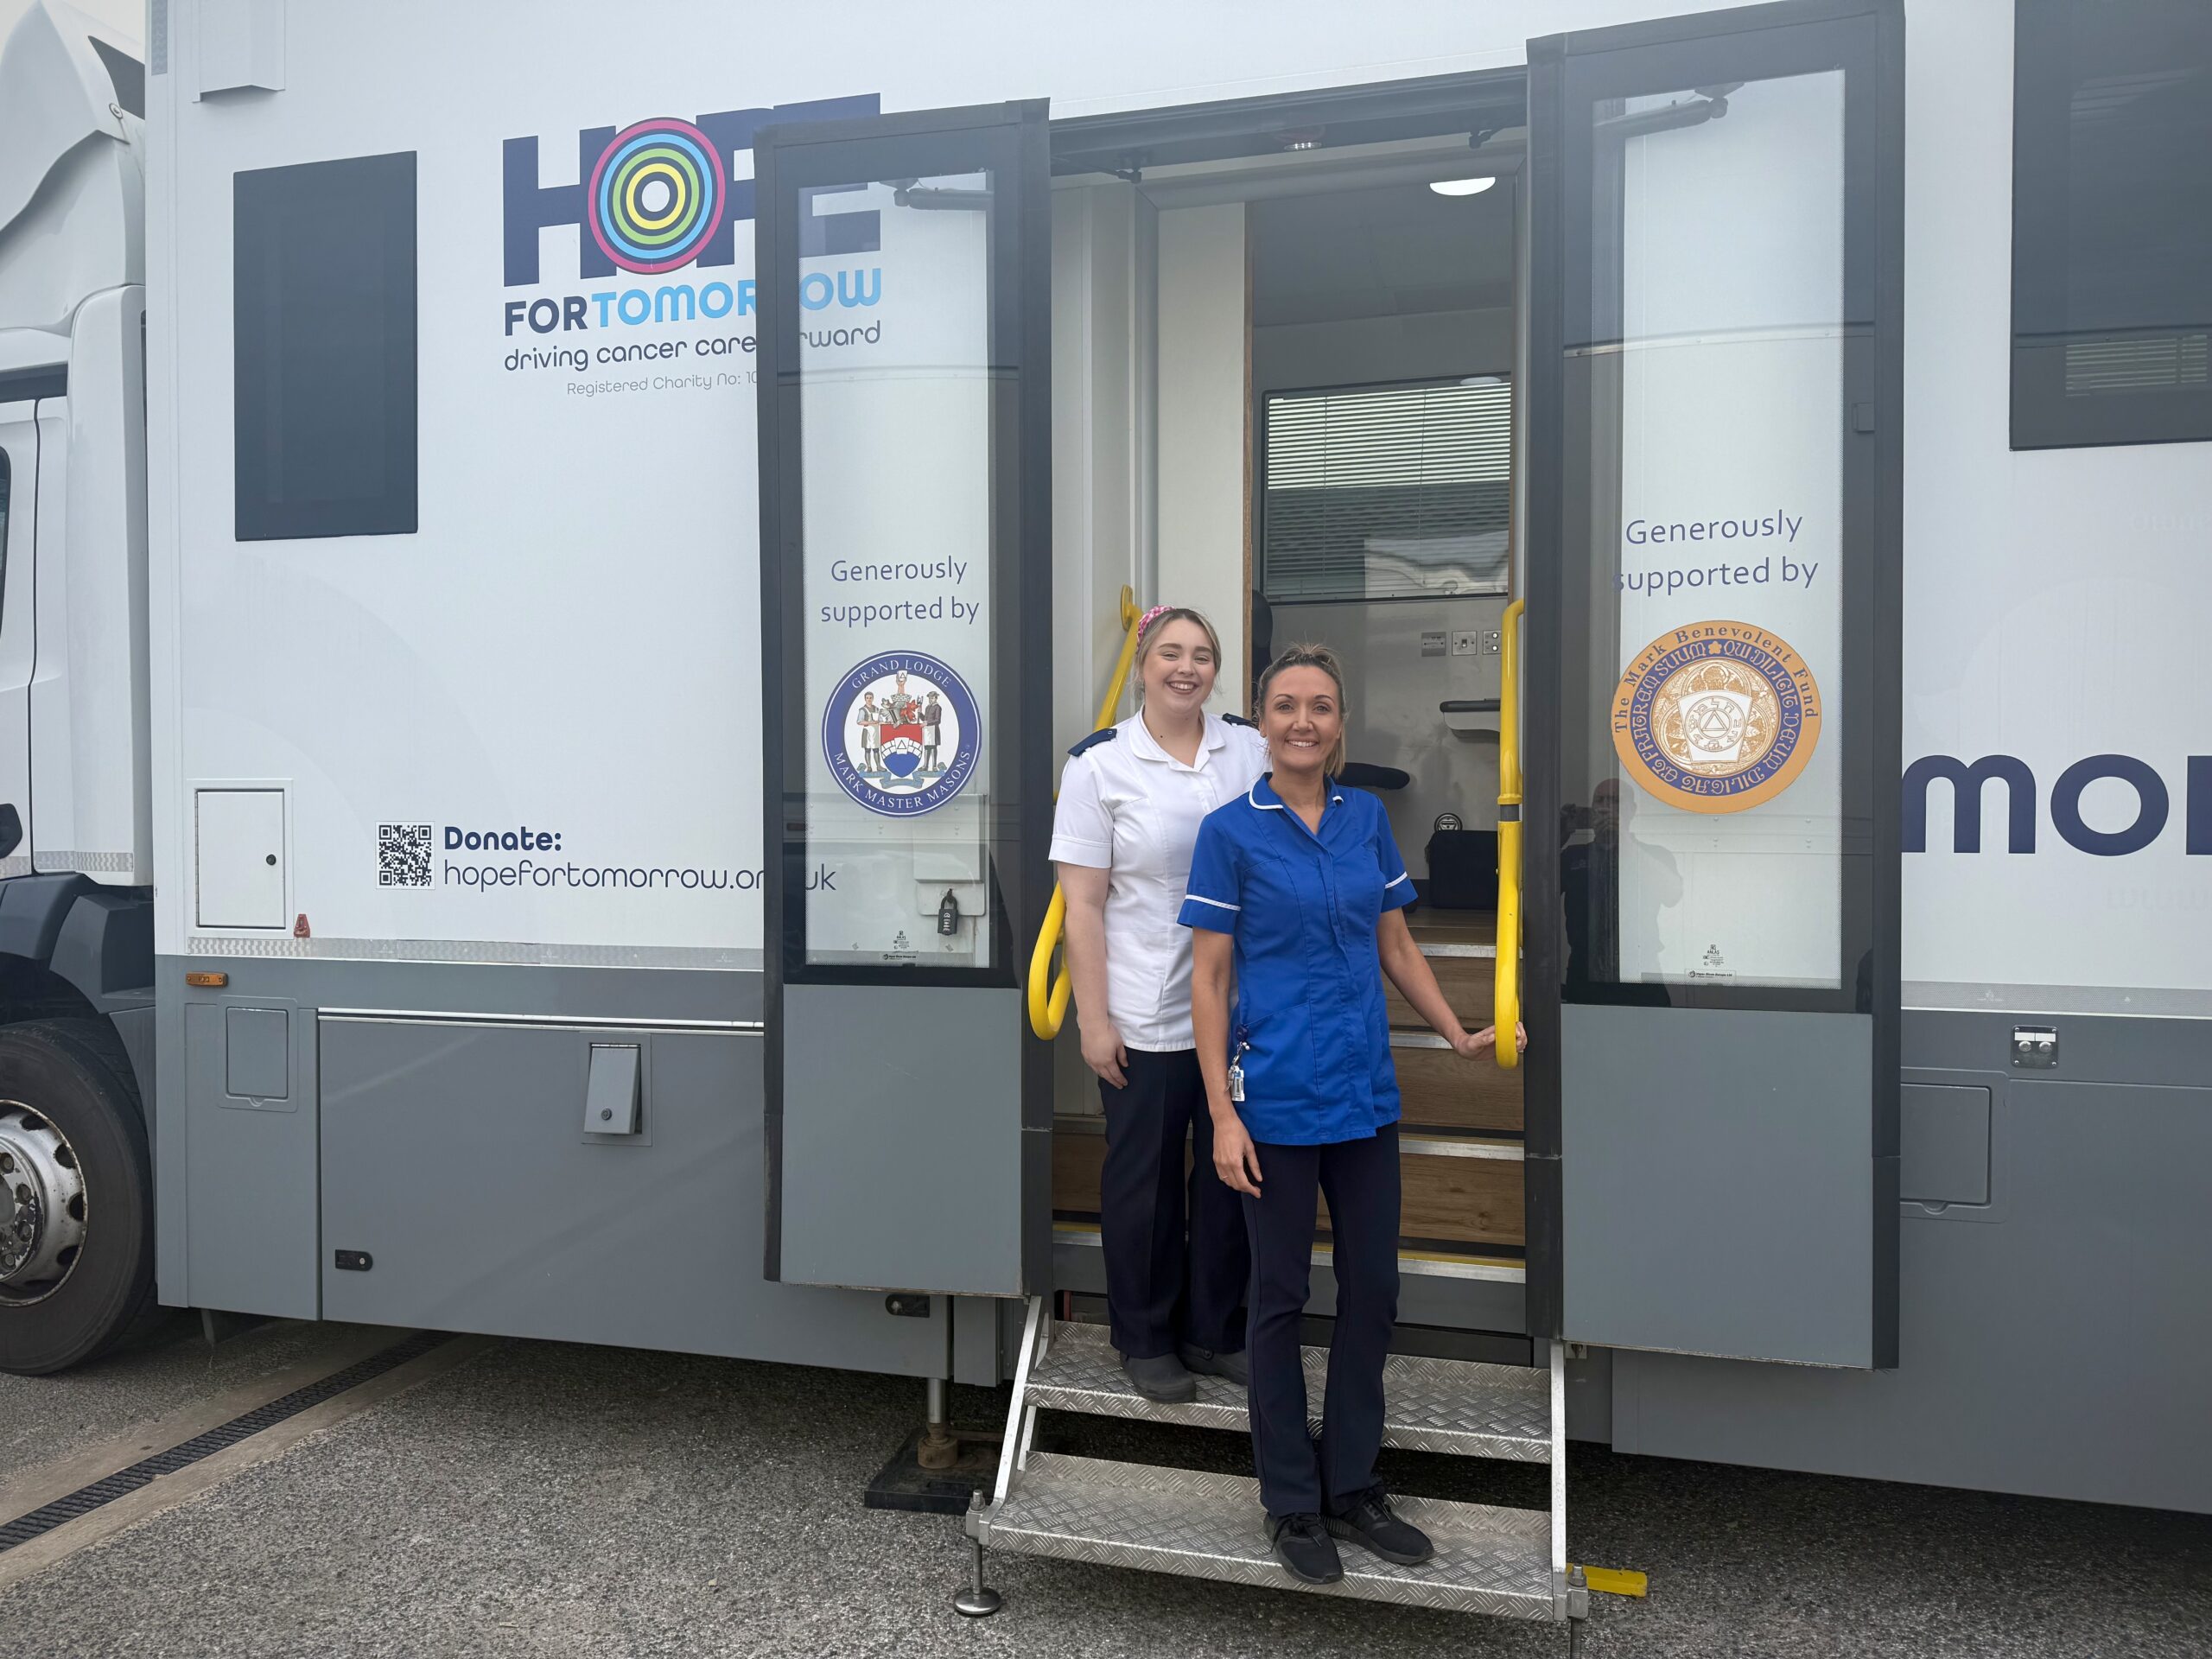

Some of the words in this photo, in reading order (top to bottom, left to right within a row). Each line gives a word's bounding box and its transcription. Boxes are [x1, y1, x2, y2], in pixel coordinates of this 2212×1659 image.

[505, 268, 881, 336] FORTOMOROW
[505, 345, 588, 372] driving
[596, 341, 688, 364] cancer
[695, 334, 756, 357] care
[567, 377, 648, 397] Registered
[652, 372, 712, 390] Charity
[717, 372, 741, 385] No:
[1625, 509, 1802, 544] Generously
[831, 555, 967, 584] Generously
[1612, 556, 1770, 597] supported
[1782, 556, 1819, 588] by
[821, 596, 943, 627] supported
[951, 595, 979, 625] by
[852, 659, 899, 689] GRAND
[905, 659, 952, 688] LODGE
[1615, 696, 1630, 733] The
[1624, 645, 1668, 687] Mark
[1674, 626, 1792, 663] Benevolent
[1793, 667, 1818, 718] Fund
[834, 753, 863, 793] MARK
[865, 789, 924, 809] MASTER
[927, 751, 970, 803] MASONS
[444, 826, 563, 851] Donate:
